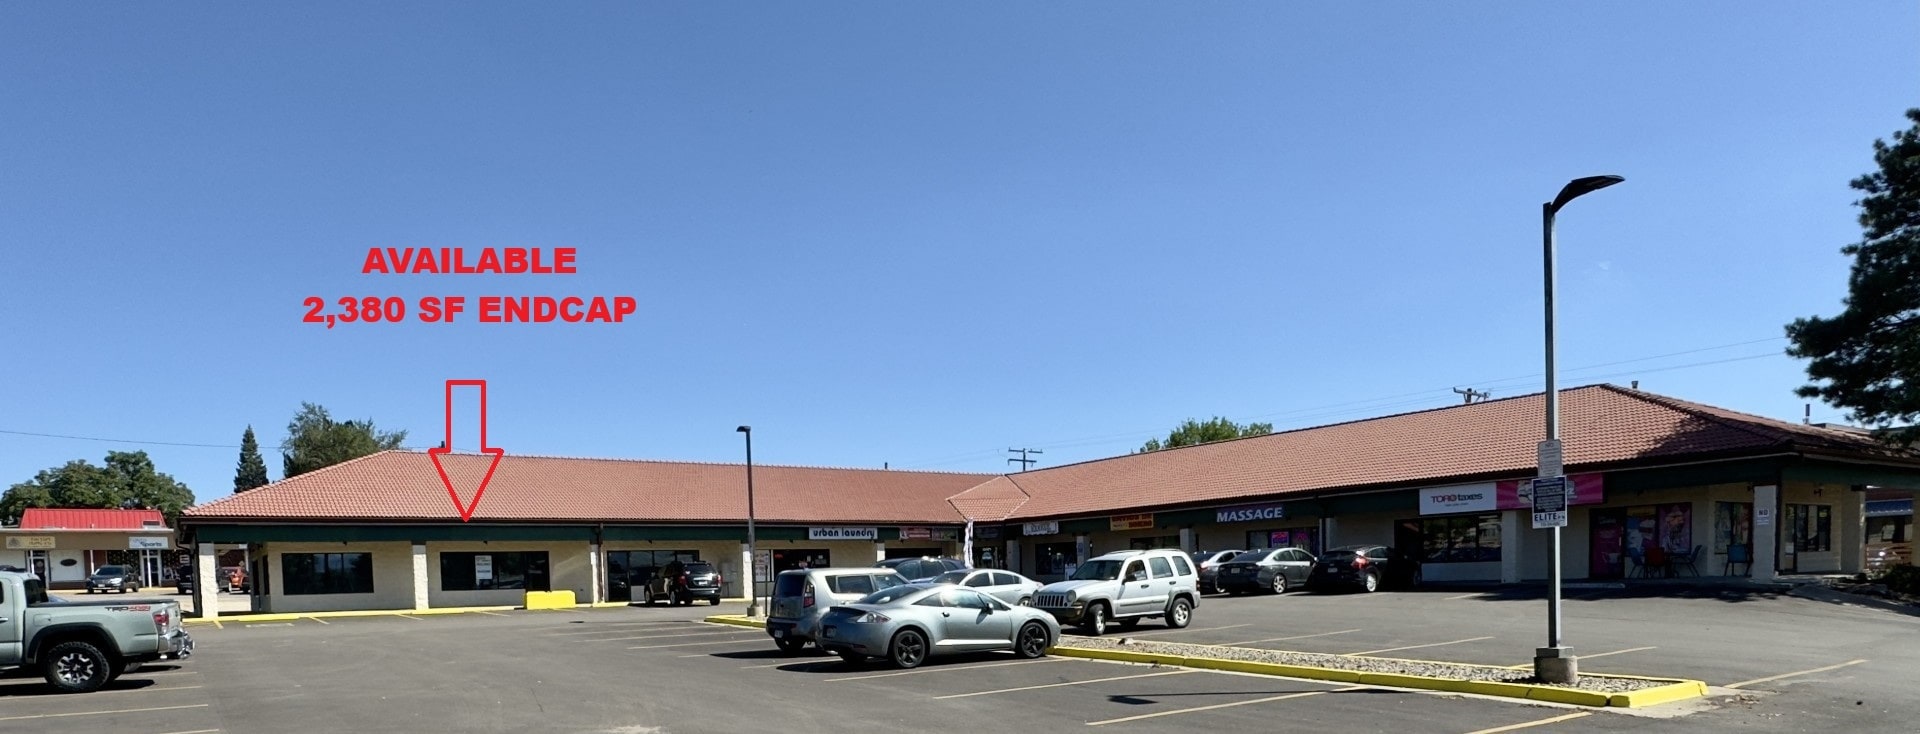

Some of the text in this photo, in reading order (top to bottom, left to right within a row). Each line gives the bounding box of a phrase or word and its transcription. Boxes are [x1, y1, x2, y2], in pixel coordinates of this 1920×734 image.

[1216, 507, 1283, 523] MASSAGE
[1534, 513, 1557, 521] ELITE
[813, 527, 875, 539] urban laundry
